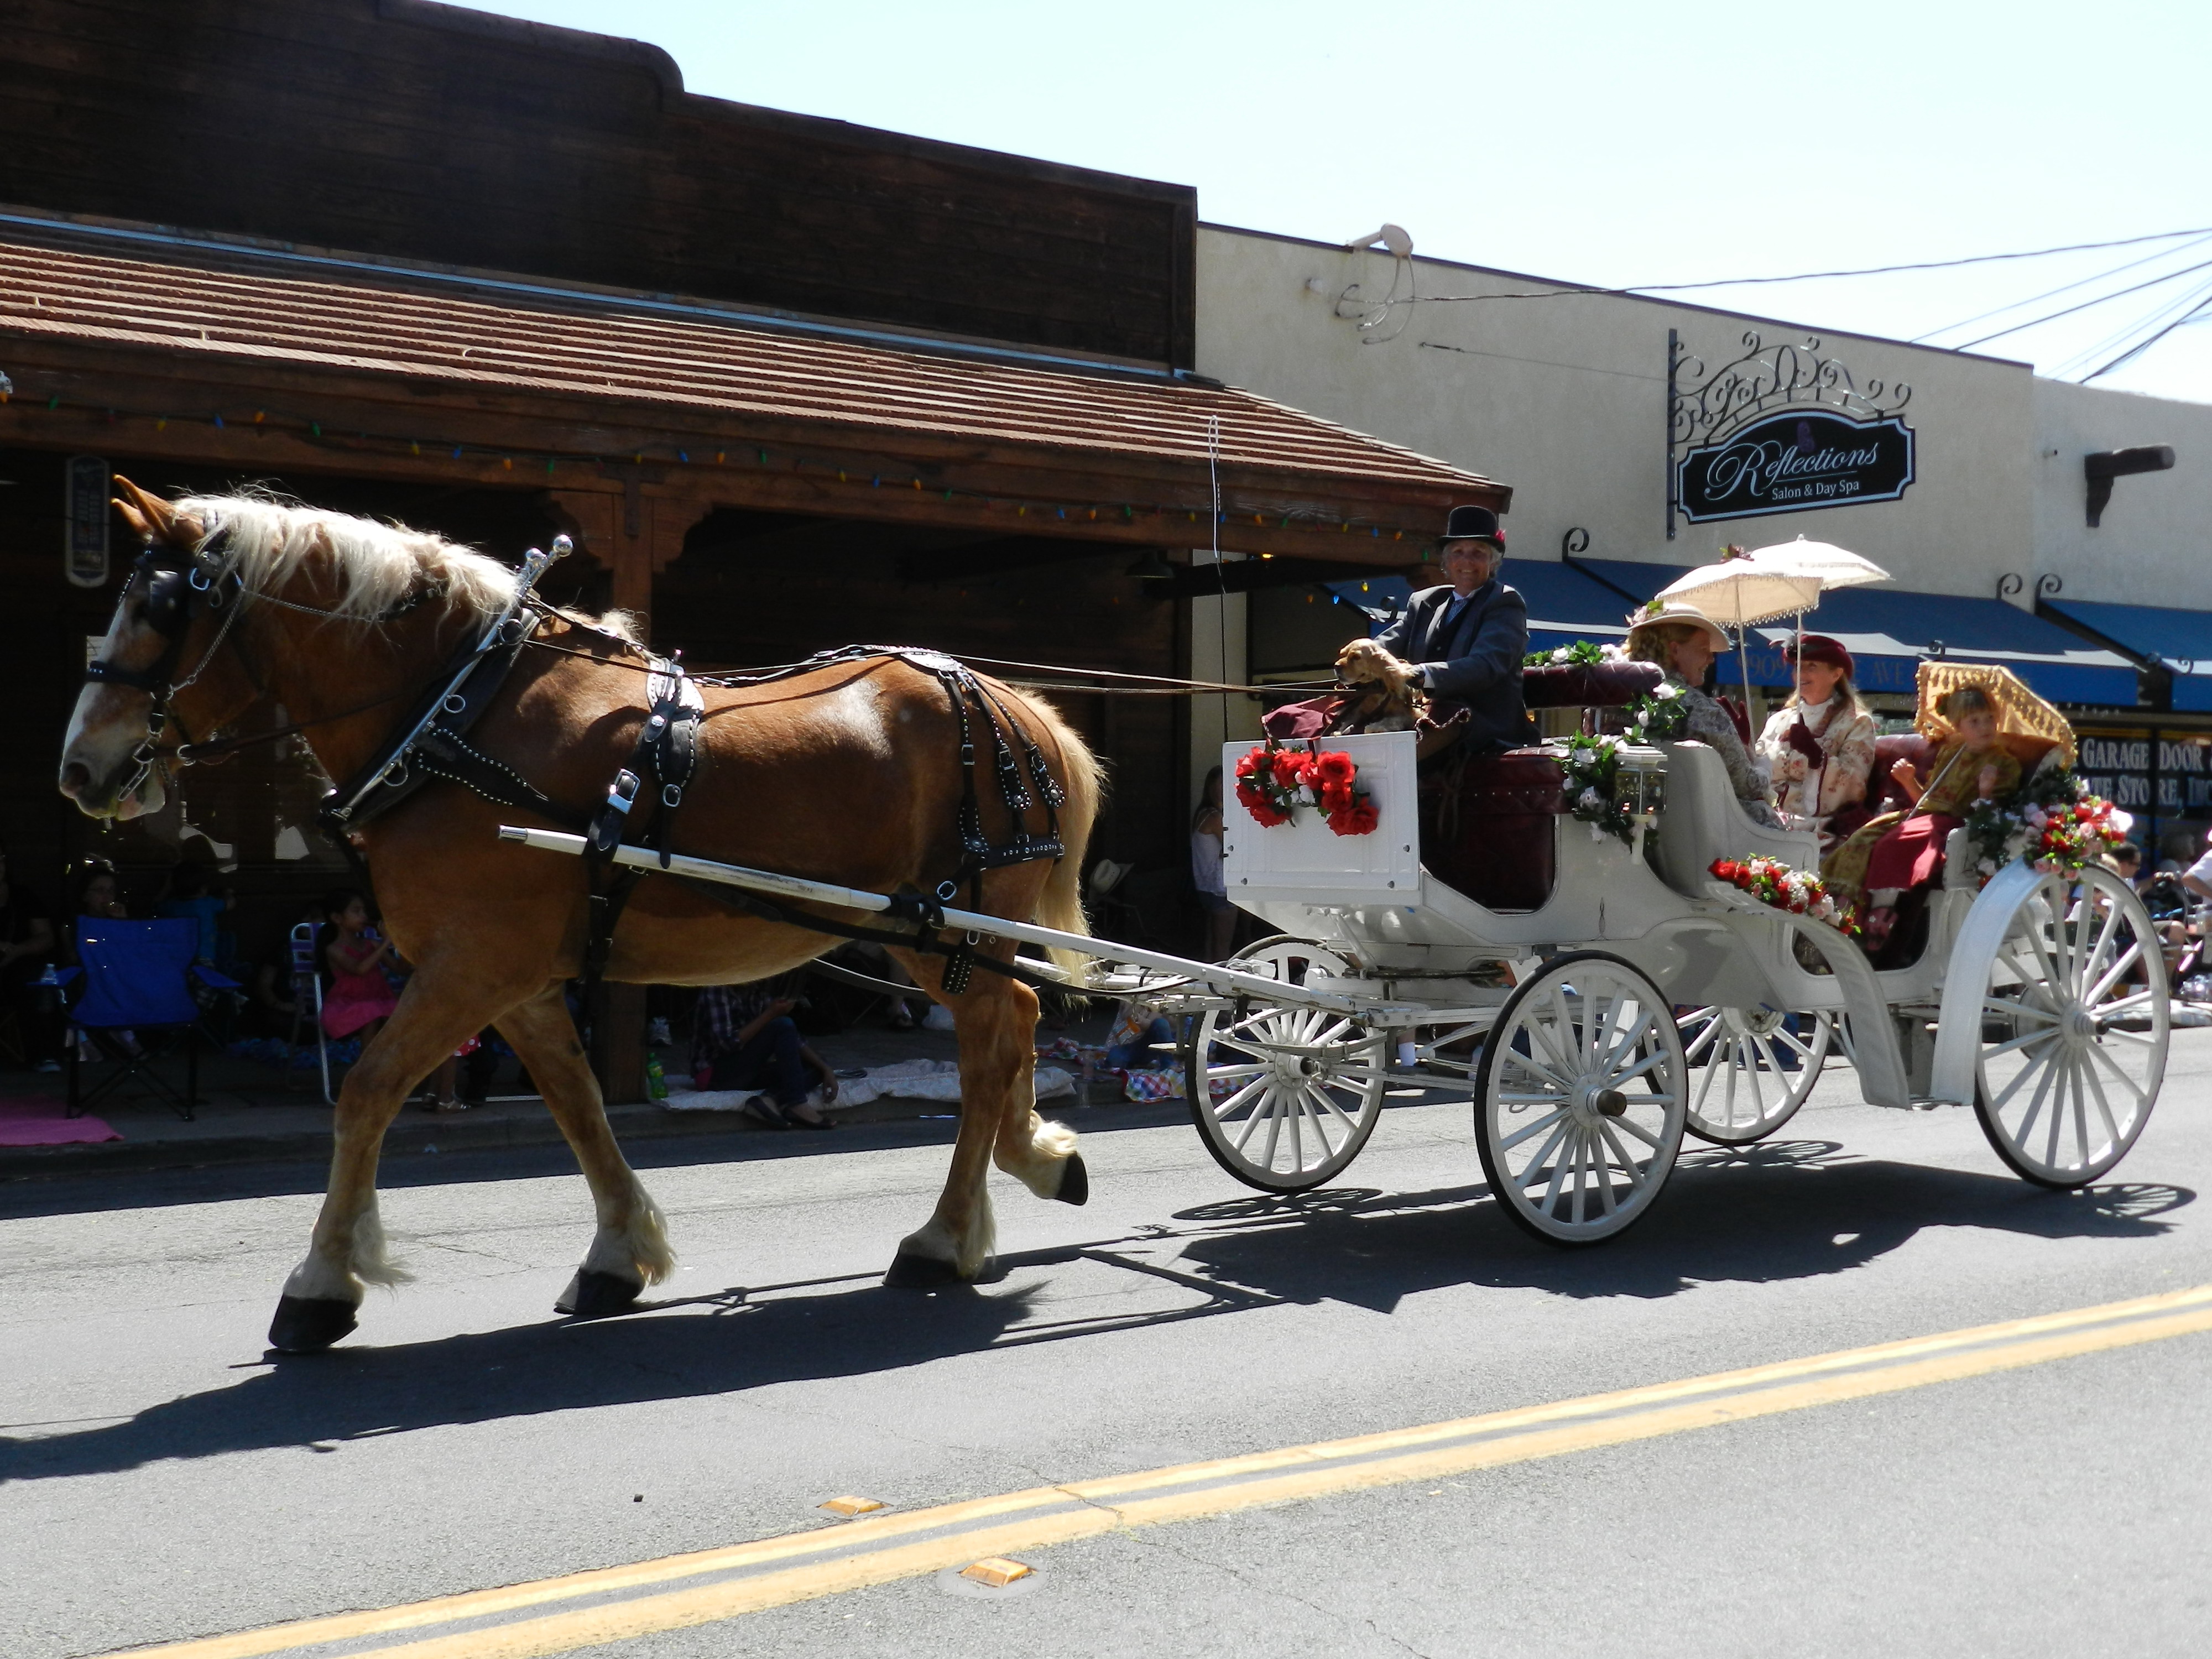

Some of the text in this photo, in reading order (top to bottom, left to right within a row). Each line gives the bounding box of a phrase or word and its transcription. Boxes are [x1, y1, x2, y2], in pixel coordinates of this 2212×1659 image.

[1703, 441, 1879, 501] Reflections
[1772, 479, 1860, 500] Salon & Day Spa
[2083, 738, 2149, 770] GARAGE
[2159, 742, 2203, 771] DOOR
